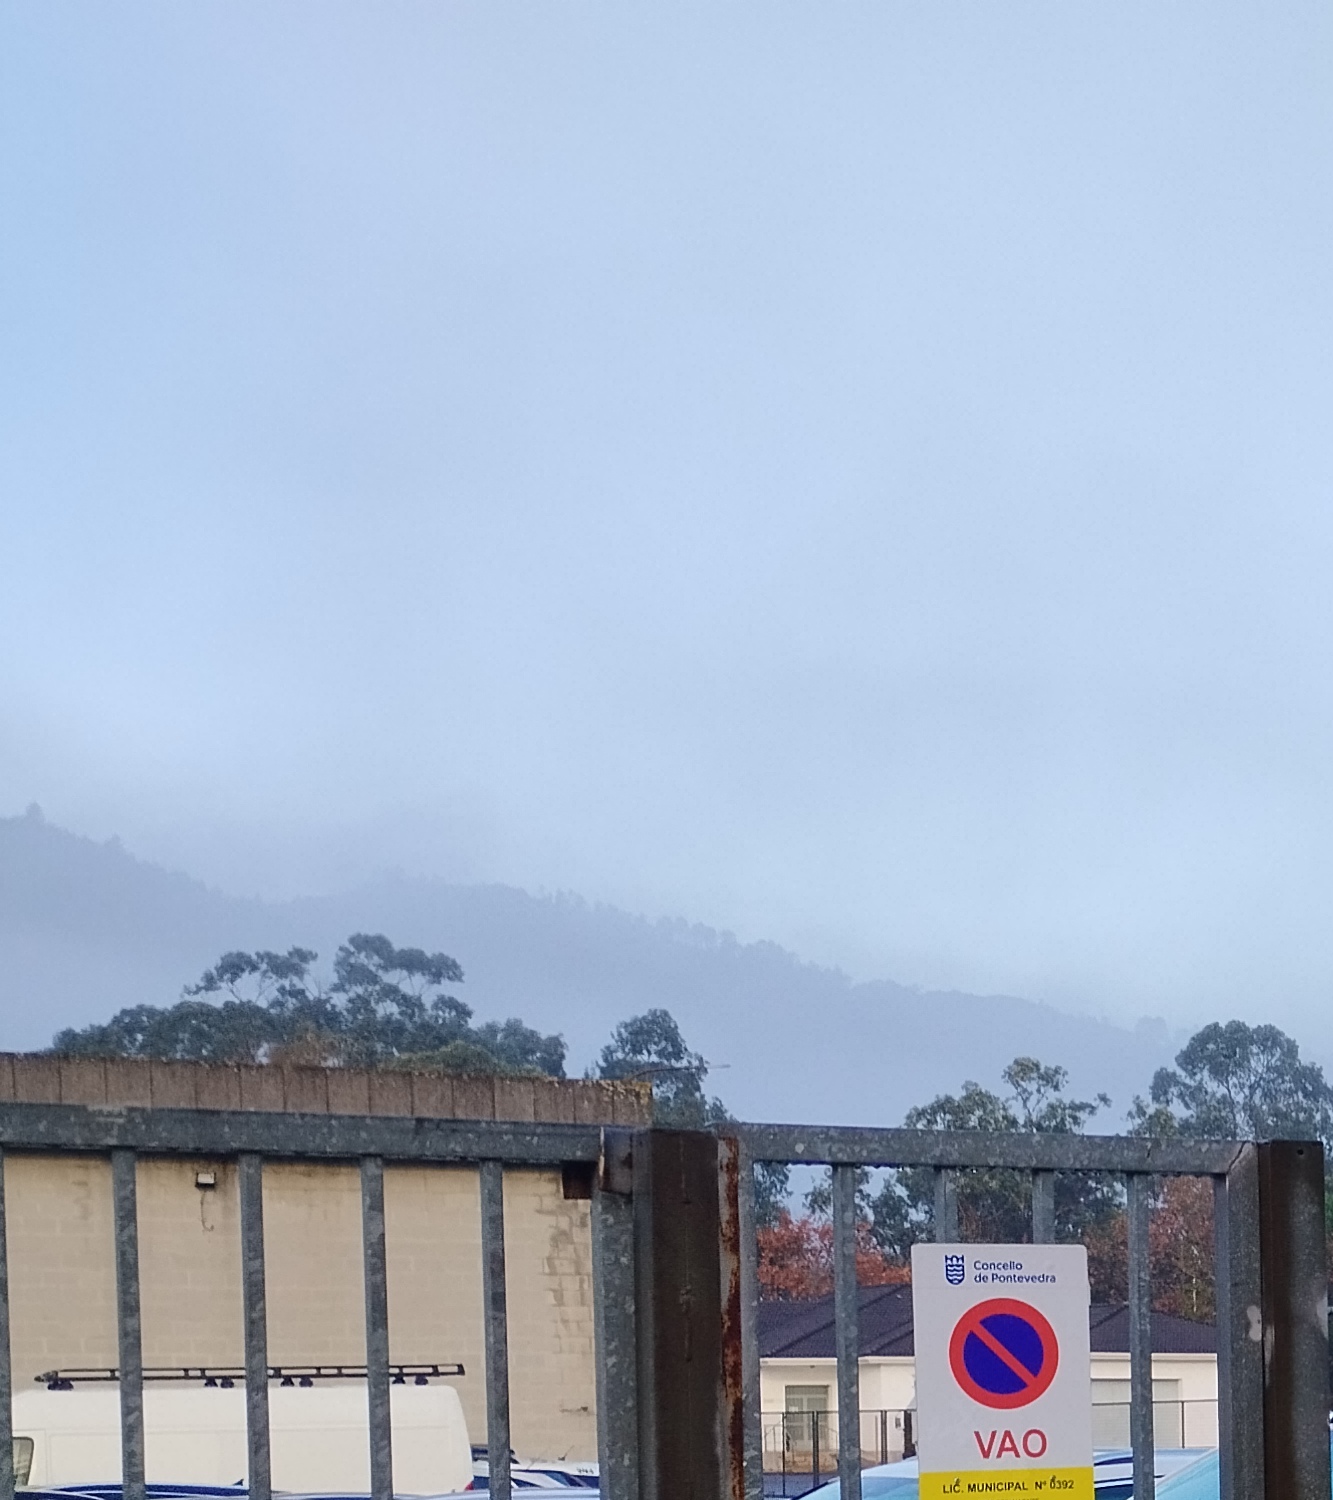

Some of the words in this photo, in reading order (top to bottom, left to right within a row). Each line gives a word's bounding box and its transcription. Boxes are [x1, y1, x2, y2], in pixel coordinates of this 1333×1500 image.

[973, 1260, 1023, 1271] Concello
[974, 1272, 988, 1283] de
[991, 1272, 1056, 1283] Pontevedra
[973, 1429, 1047, 1459] VAO
[967, 1481, 1028, 1493] MUNICIPAL
[1049, 1479, 1075, 1490] 0392
